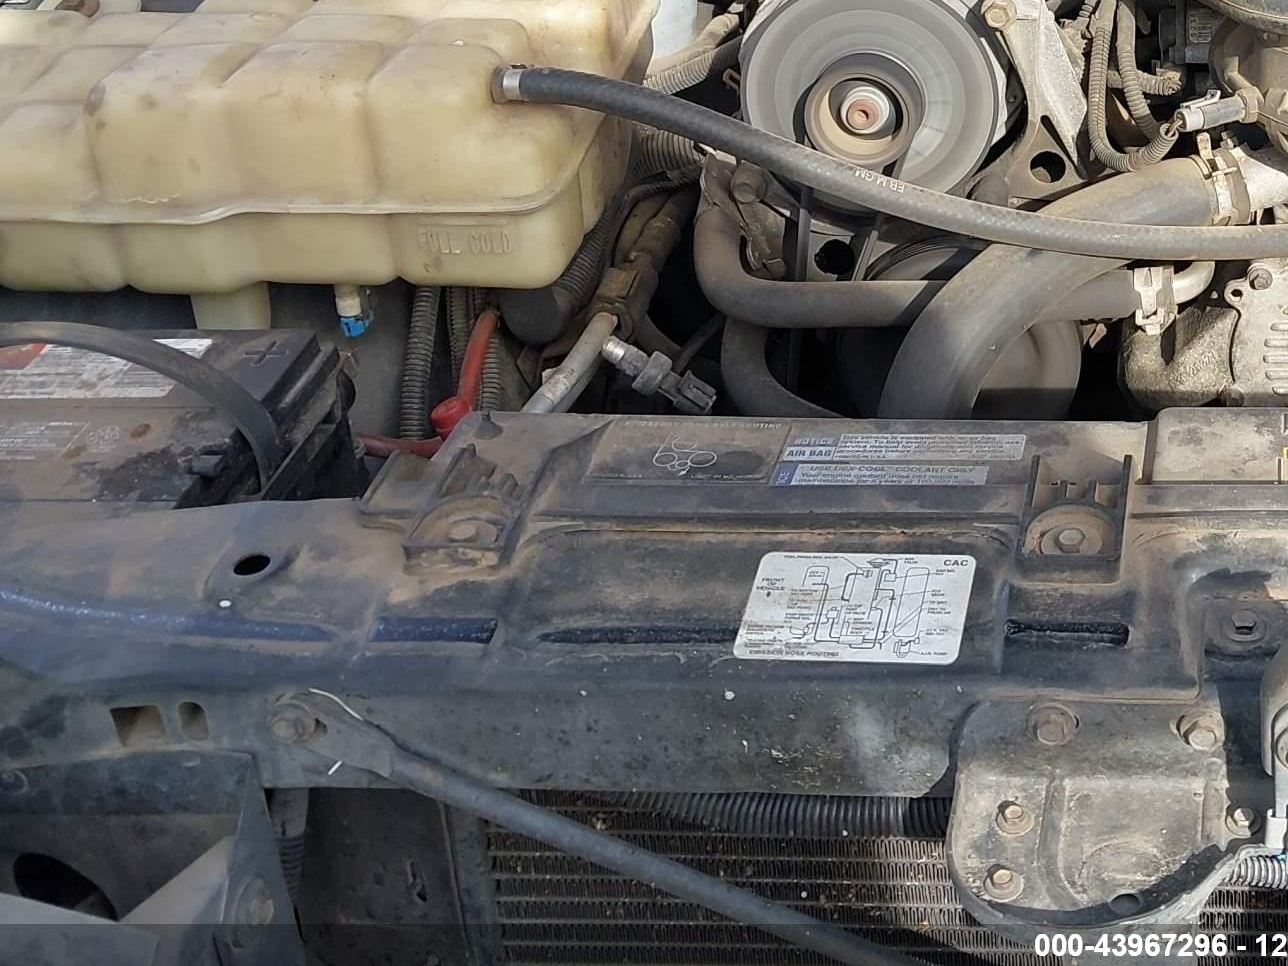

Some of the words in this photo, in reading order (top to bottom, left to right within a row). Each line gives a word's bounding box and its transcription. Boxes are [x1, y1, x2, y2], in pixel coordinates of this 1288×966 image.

[418, 229, 460, 254] FULL
[787, 449, 806, 457] AIR
[809, 449, 832, 457] BAG
[943, 559, 969, 567] CAC
